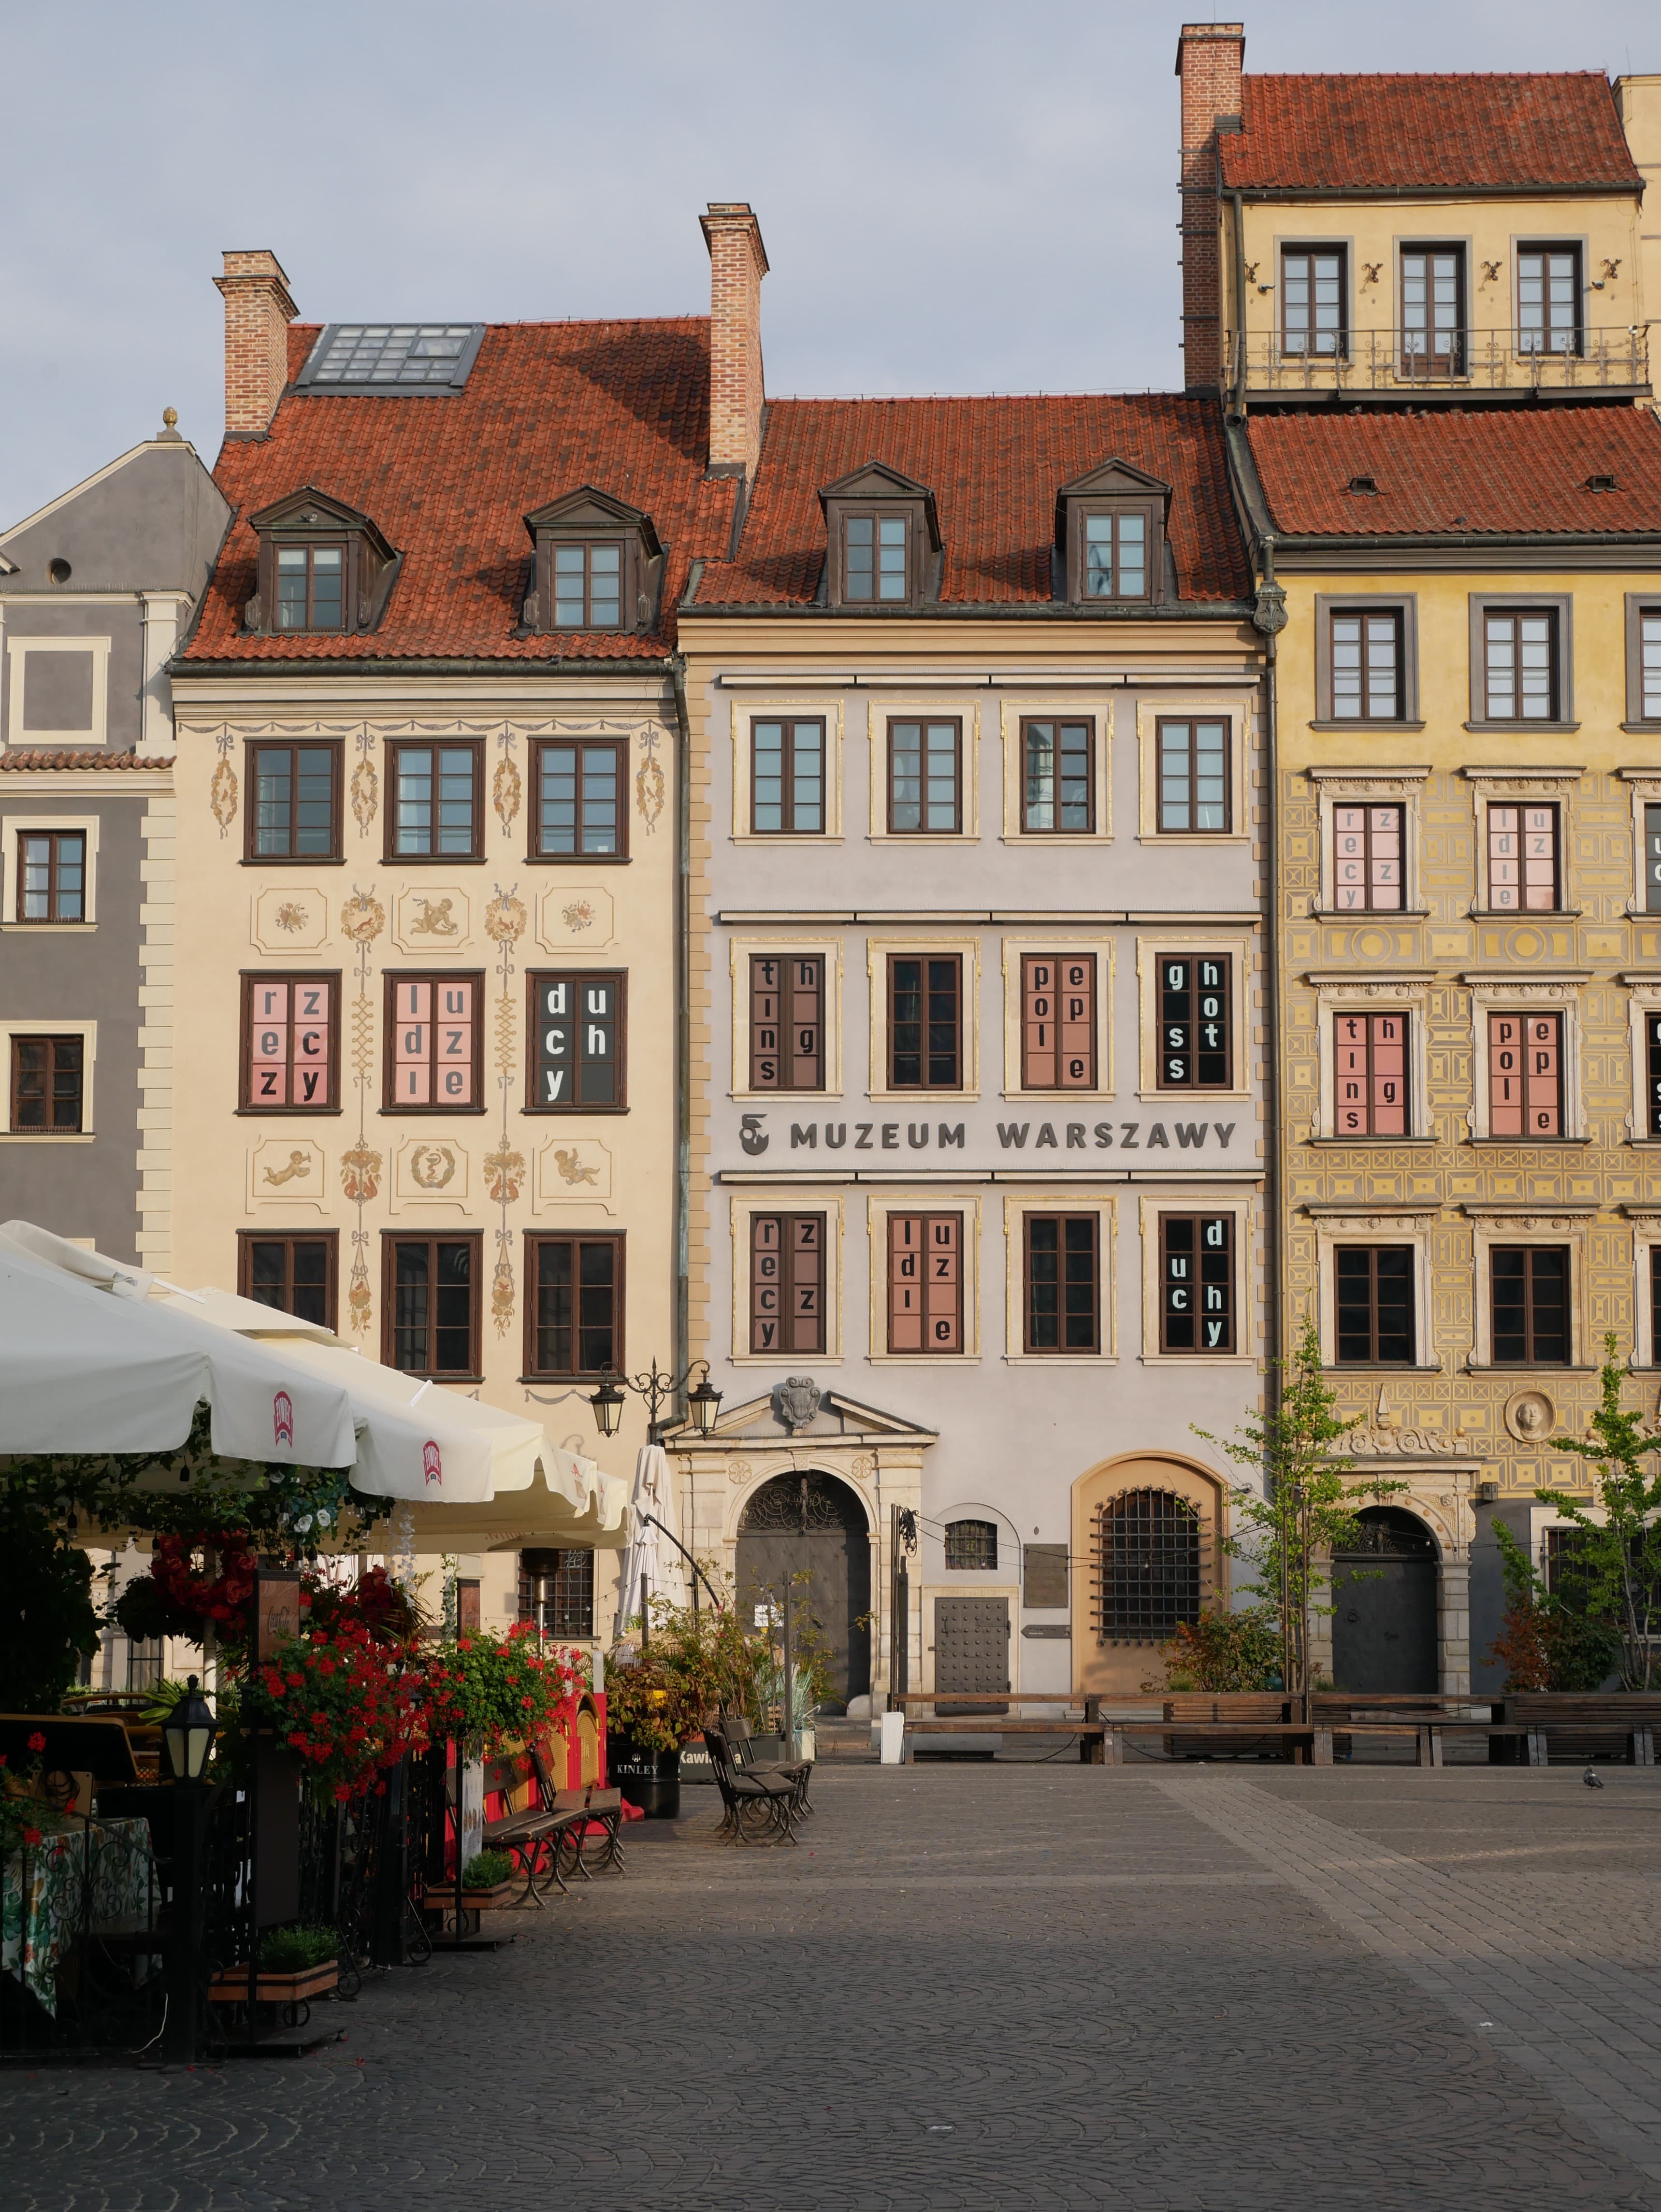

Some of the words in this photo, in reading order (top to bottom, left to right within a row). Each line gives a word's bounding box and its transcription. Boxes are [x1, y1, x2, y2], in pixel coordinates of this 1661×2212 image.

[791, 1122, 966, 1149] MUZEUM
[996, 1122, 1236, 1149] WARSZAWY
[617, 1764, 659, 1774] KINLEY
